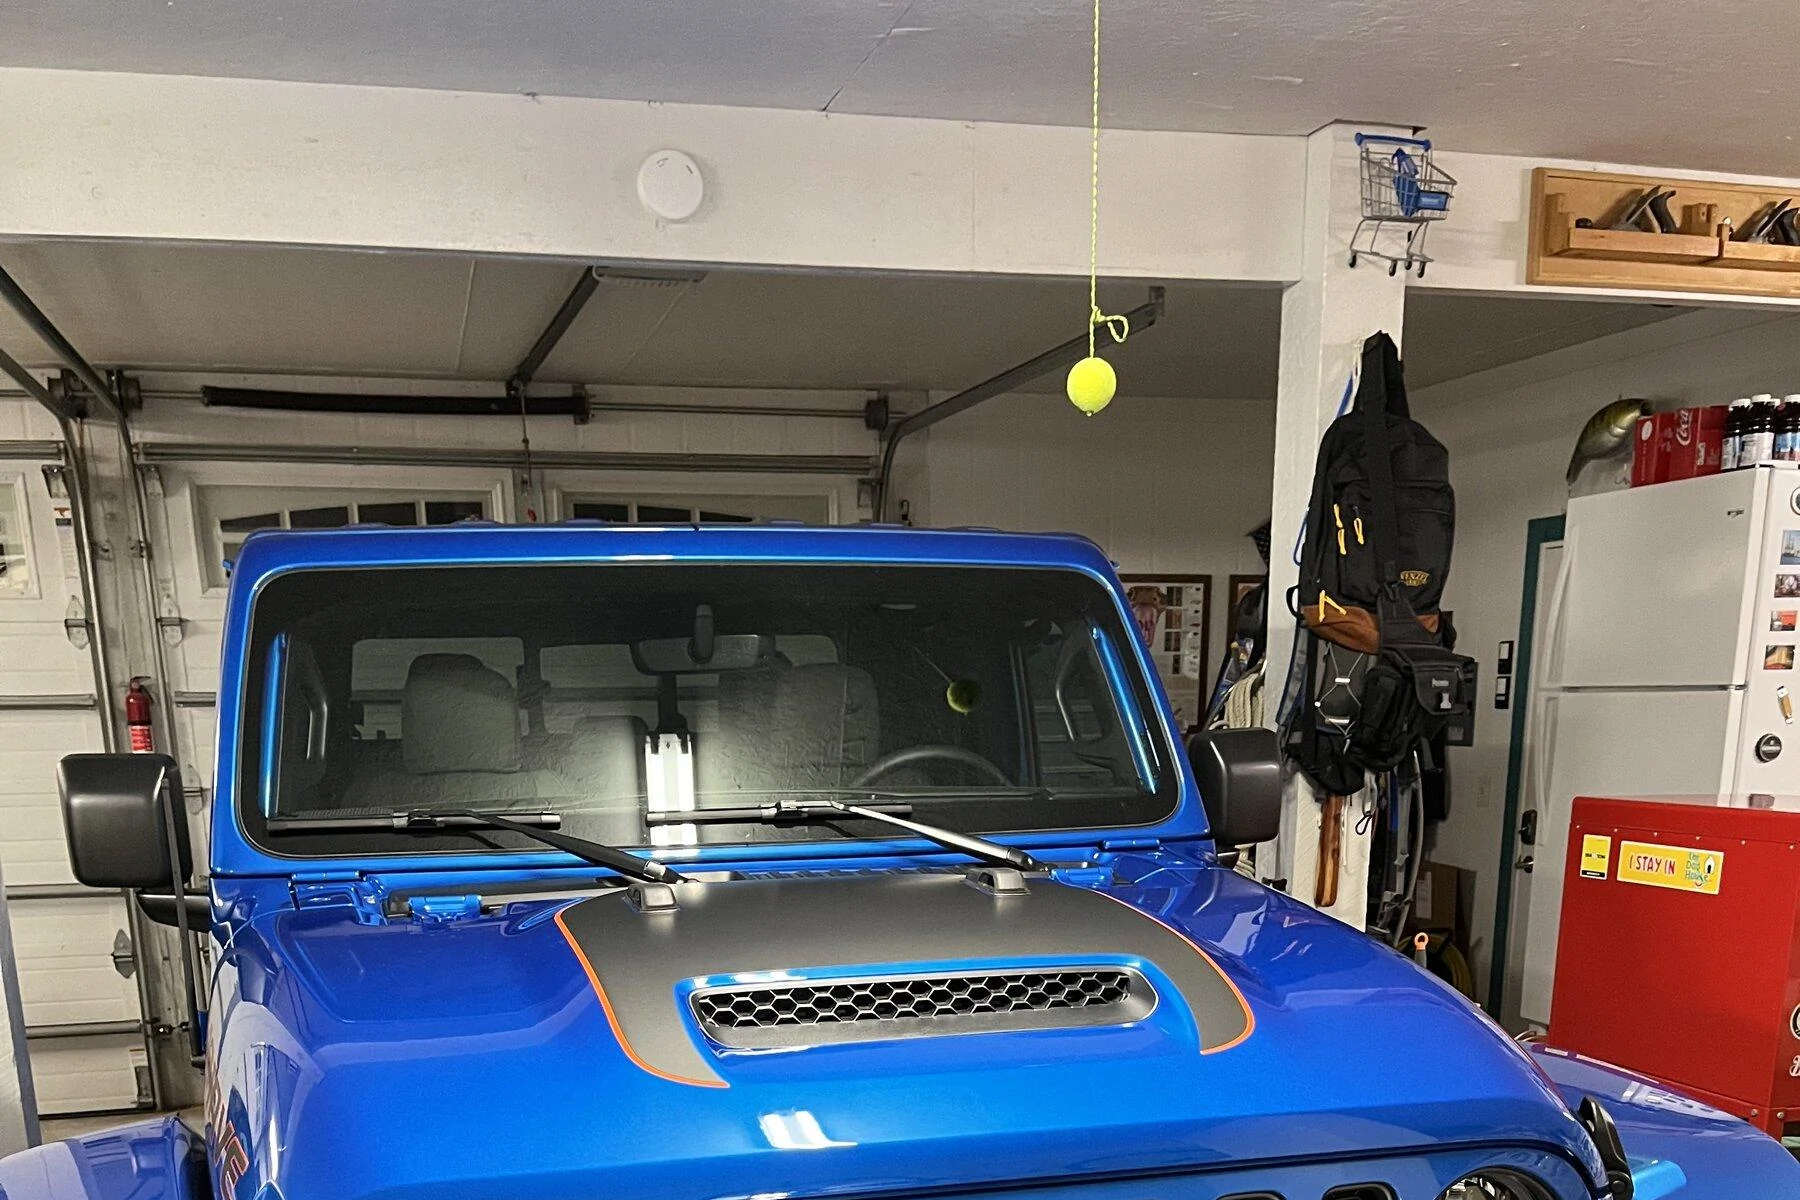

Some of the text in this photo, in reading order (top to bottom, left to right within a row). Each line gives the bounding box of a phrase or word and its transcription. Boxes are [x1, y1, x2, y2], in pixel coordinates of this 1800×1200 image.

[1676, 409, 1692, 446] Coca
[1629, 854, 1676, 876] I STAY IN
